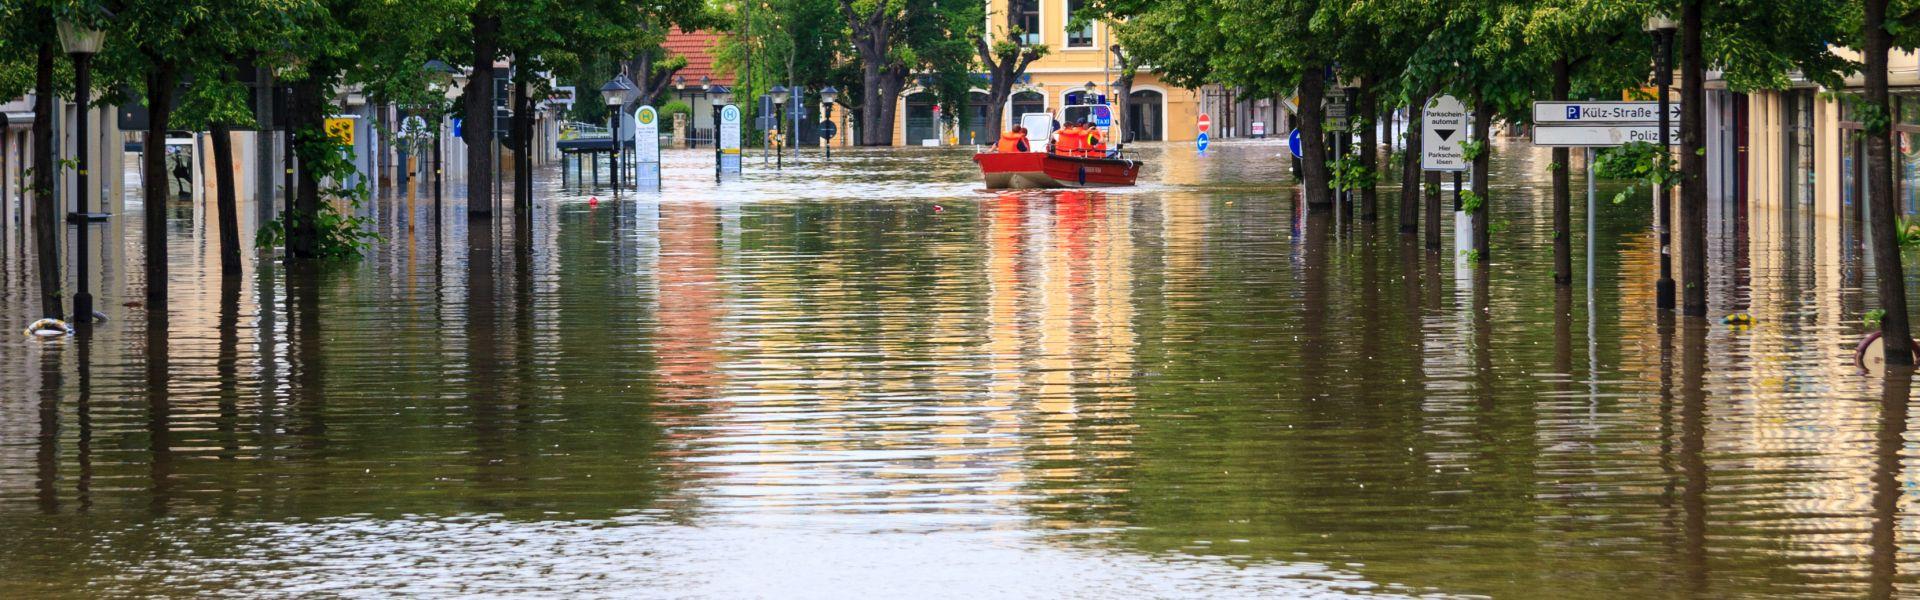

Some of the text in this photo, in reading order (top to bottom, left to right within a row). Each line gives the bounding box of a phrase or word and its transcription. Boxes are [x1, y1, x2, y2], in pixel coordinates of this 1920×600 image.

[1568, 107, 1651, 118] P Külz-Straße
[1630, 130, 1658, 140] Poliz
